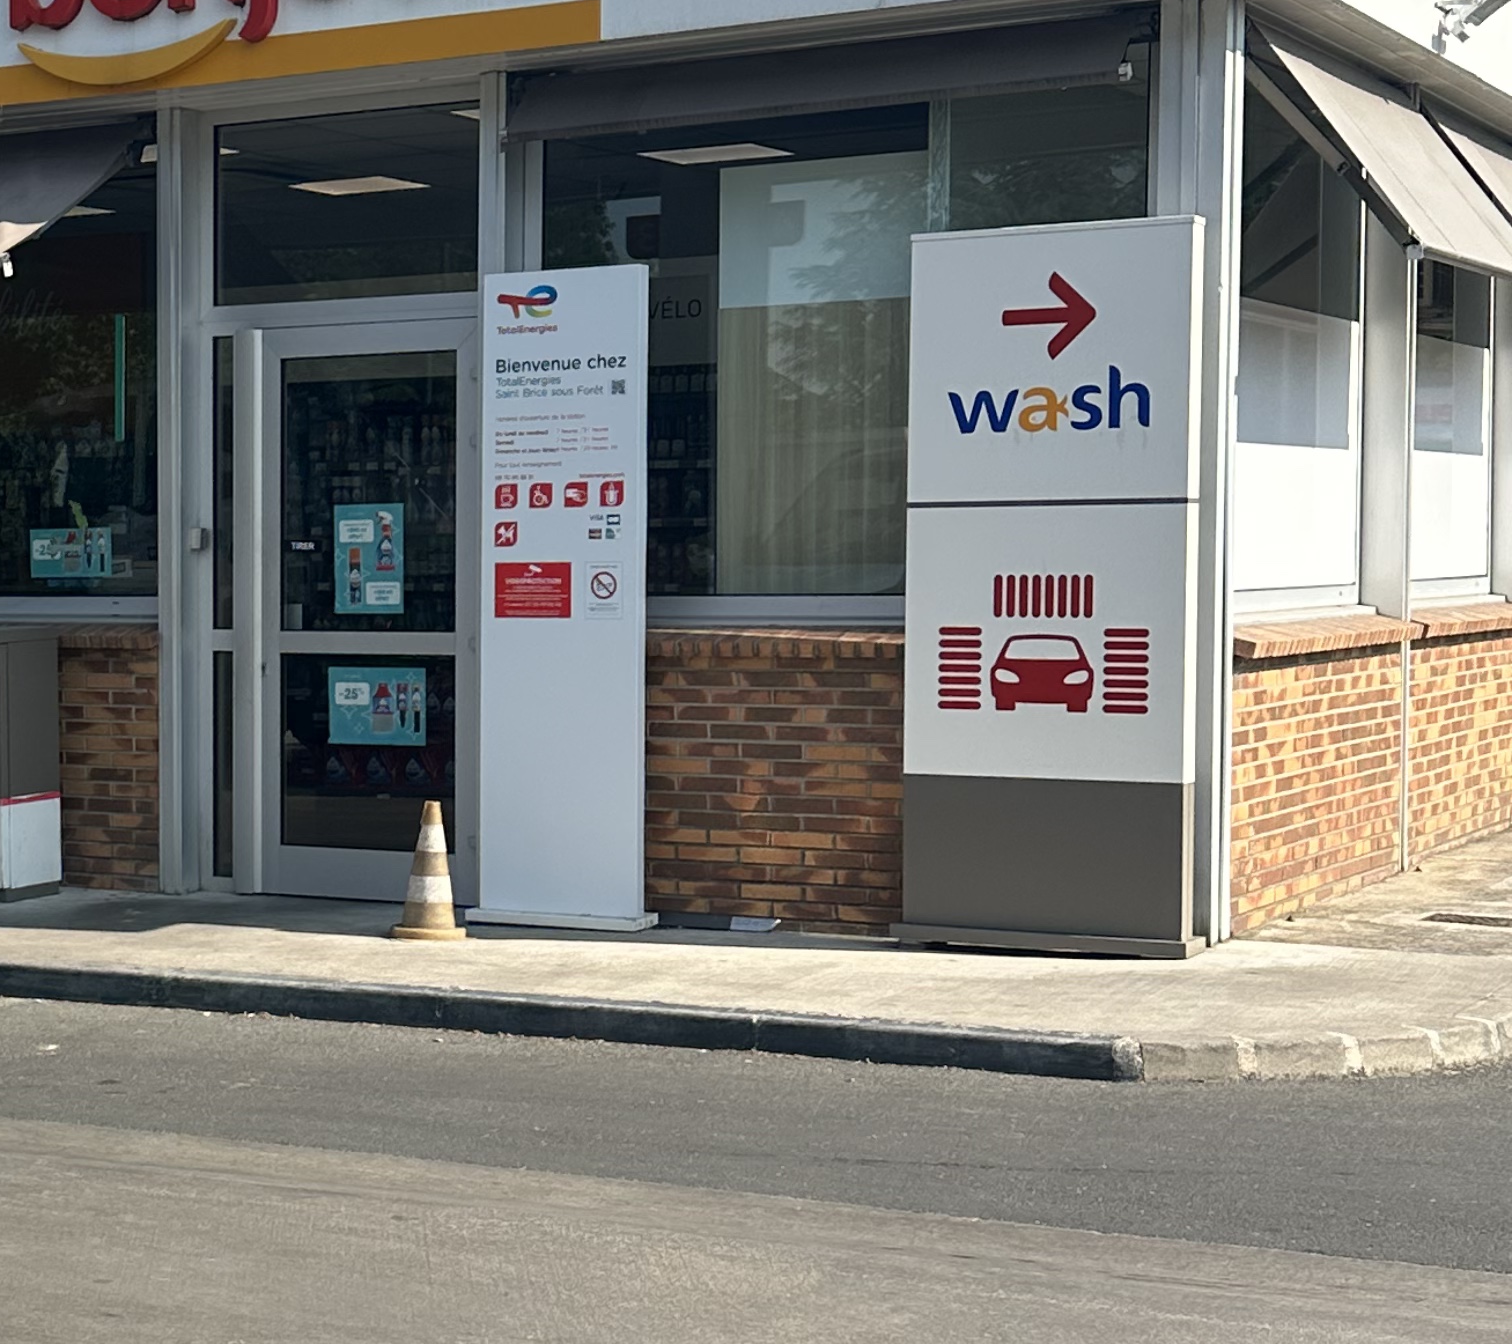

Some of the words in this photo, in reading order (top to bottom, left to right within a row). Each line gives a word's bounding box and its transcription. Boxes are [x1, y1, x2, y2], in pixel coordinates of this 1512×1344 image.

[496, 323, 559, 335] TotalEnergies
[495, 358, 582, 374] Bienvenue
[587, 353, 627, 369] chez
[496, 376, 562, 387] TotalEnergies
[495, 389, 520, 399] Saint
[523, 387, 548, 398] Brice
[551, 388, 574, 397] sous
[947, 365, 1151, 434] wash
